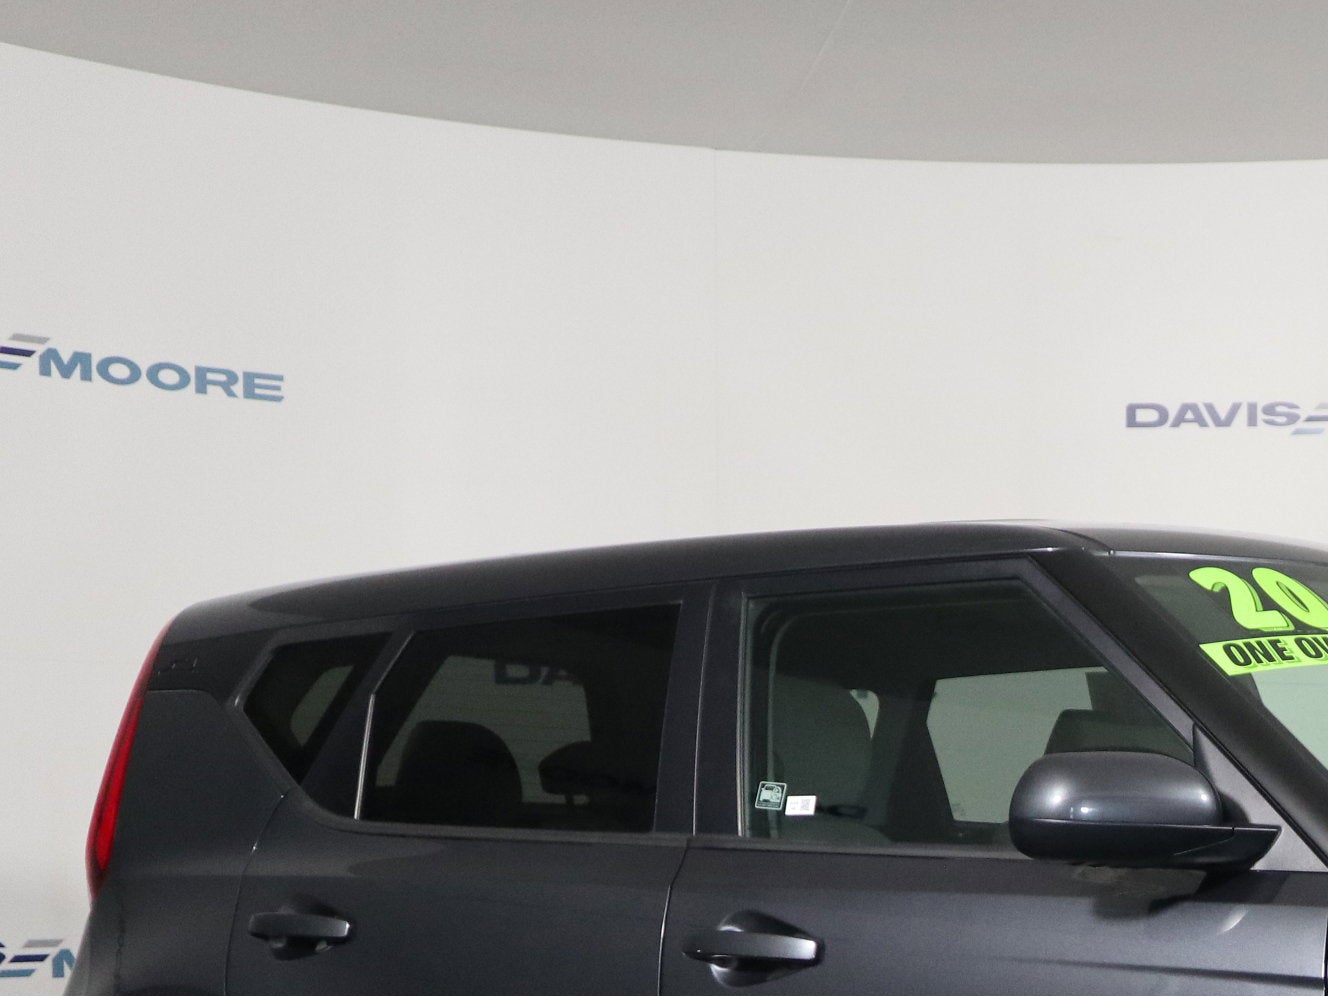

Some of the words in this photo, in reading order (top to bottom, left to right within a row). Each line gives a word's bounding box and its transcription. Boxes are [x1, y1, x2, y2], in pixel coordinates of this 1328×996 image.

[38, 347, 284, 402] MOORE
[1125, 401, 1301, 428] DAVIS
[1222, 637, 1294, 668] ONE
